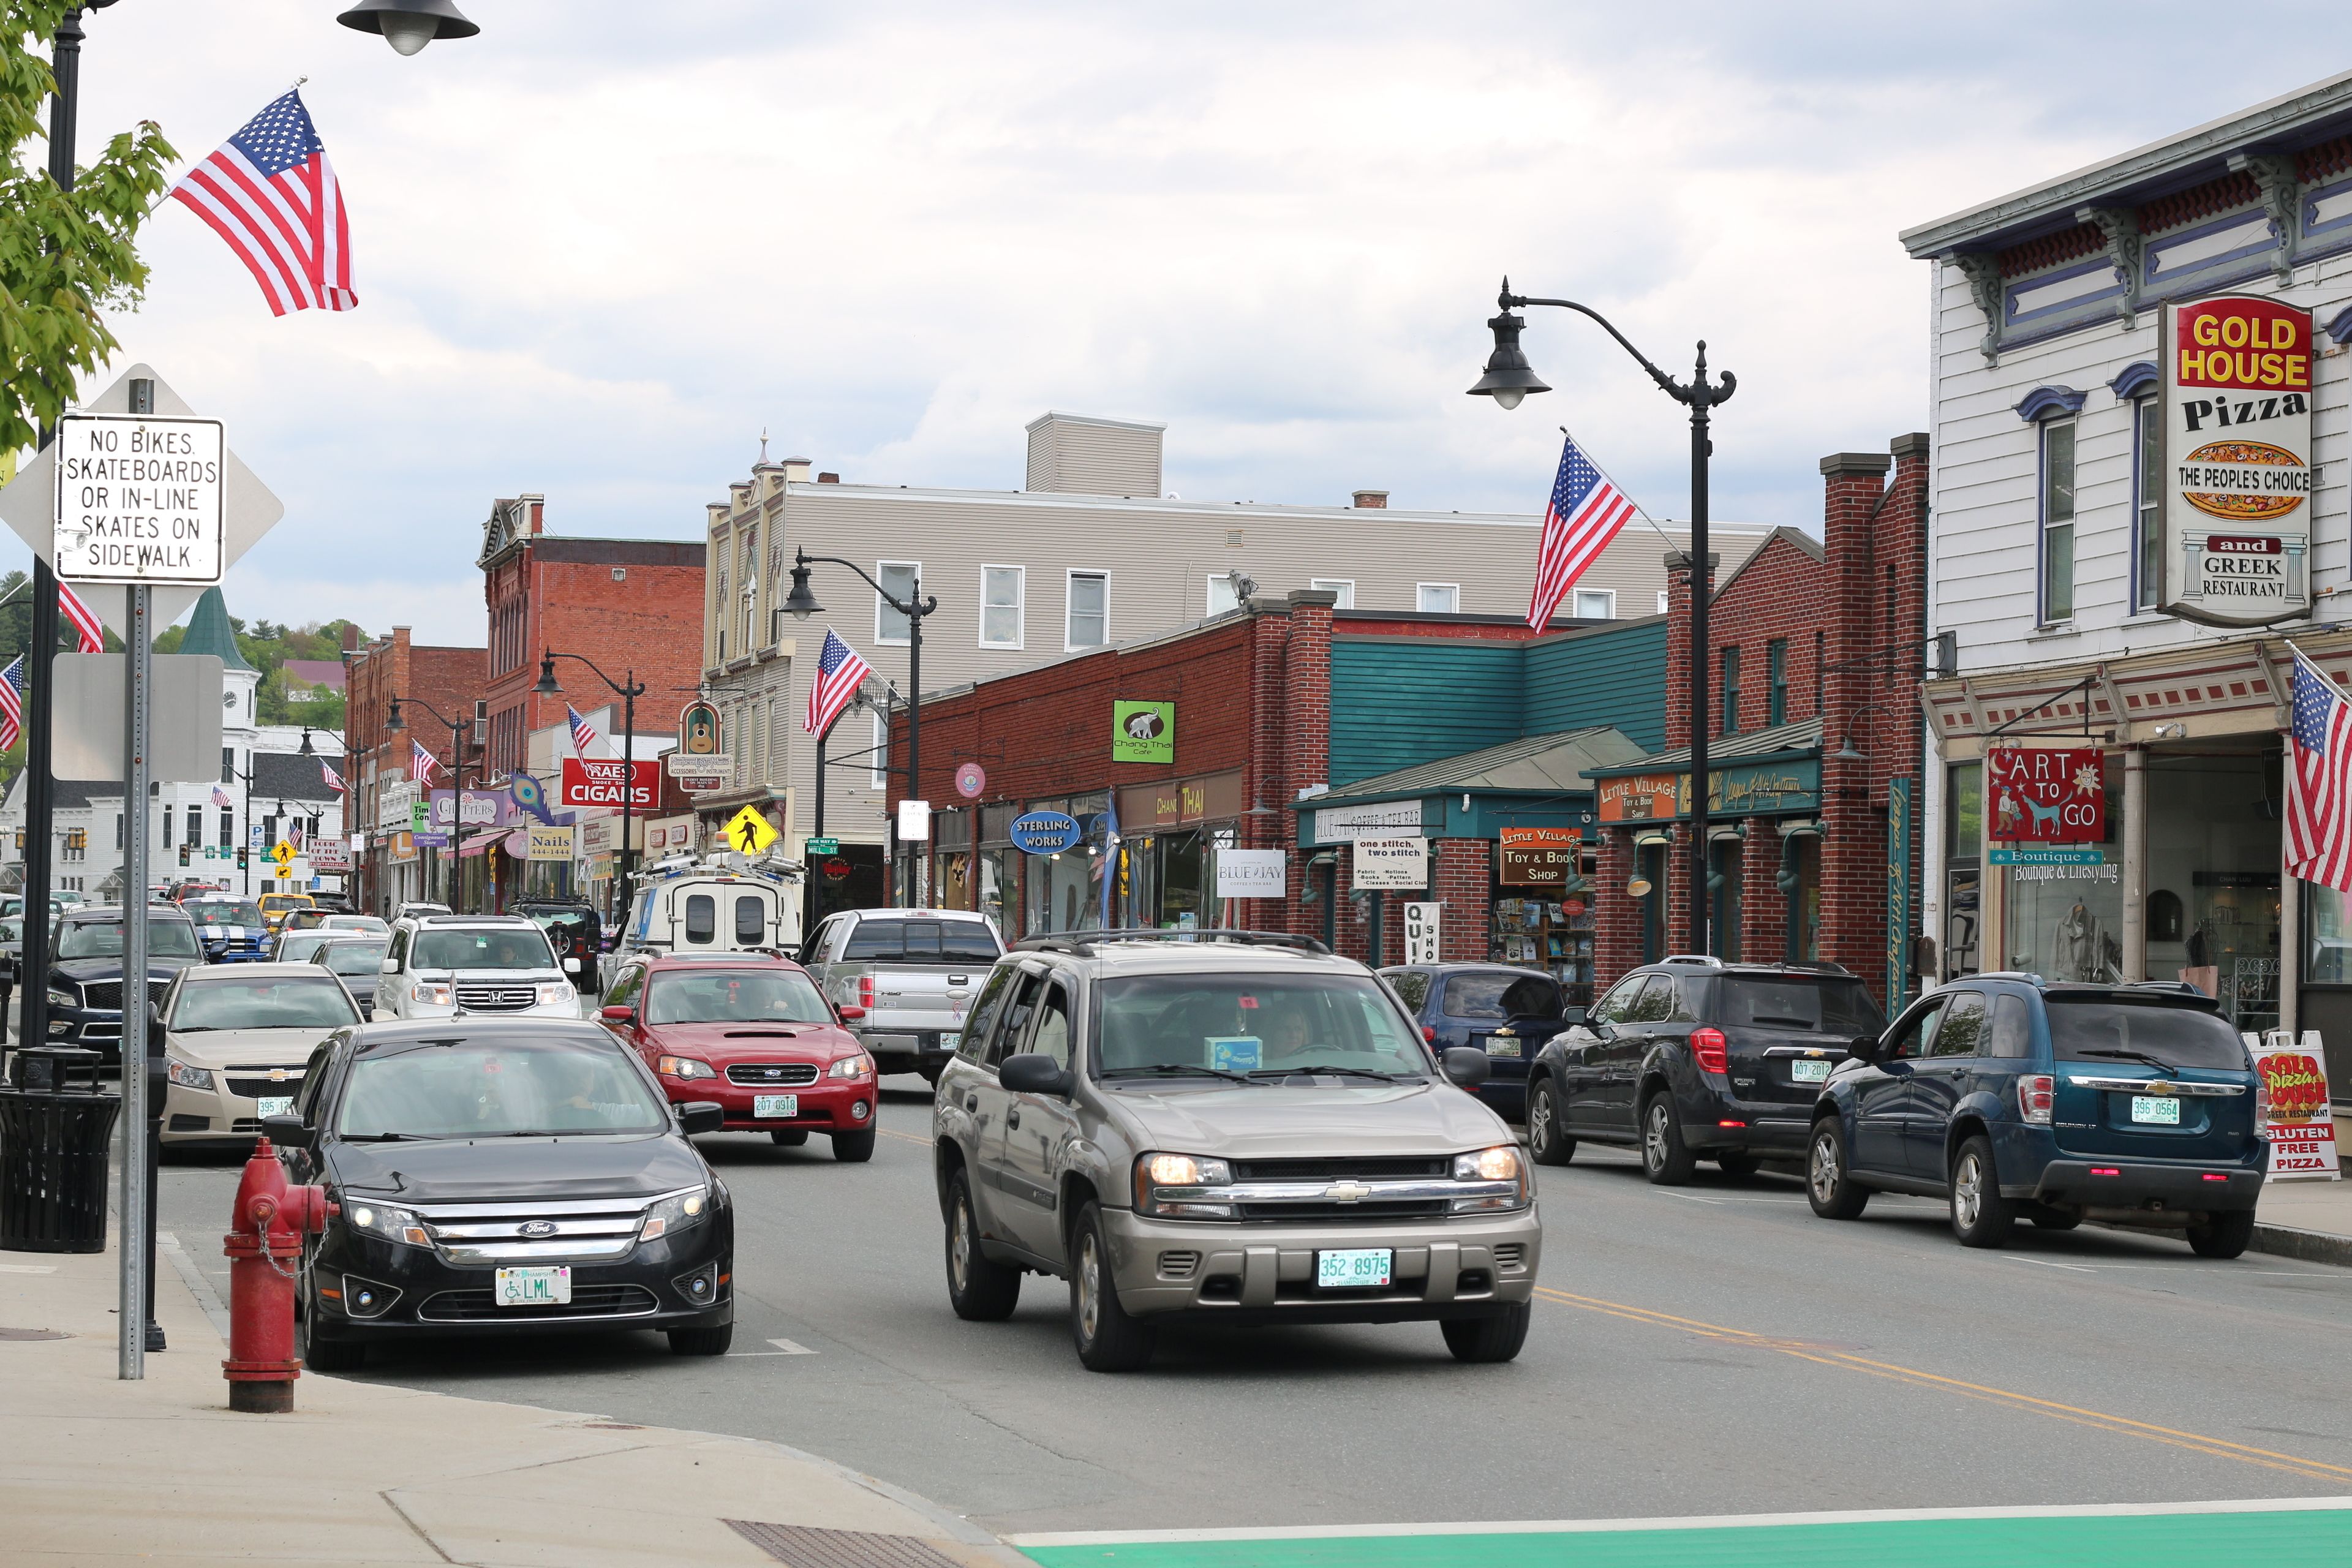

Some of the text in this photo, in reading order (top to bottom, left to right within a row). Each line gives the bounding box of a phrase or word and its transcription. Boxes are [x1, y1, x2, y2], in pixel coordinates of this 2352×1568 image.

[2193, 314, 2297, 350] GOLD
[2180, 349, 2307, 386] HOUSE
[2181, 392, 2308, 432] Pizza
[91, 431, 118, 452] NO
[67, 458, 217, 483] SKATEBOARDS
[2179, 467, 2310, 491] THE PEOPLE'S CHOICE
[81, 486, 198, 510] OR IN-LINE
[82, 515, 200, 540] SKATES ON
[2220, 538, 2269, 552] and
[89, 544, 191, 568] SIDEWALK
[2204, 557, 2282, 575] GREEK
[2203, 579, 2285, 598] RESTAURANT
[1114, 740, 1148, 748] Chang
[2009, 753, 2071, 780] ART
[570, 785, 650, 803] CIGARS
[1600, 776, 1676, 804] LITTLE VILLAGE
[2035, 782, 2060, 799] TO
[440, 799, 493, 815] CHTTERS
[2064, 804, 2096, 826] GO
[253, 826, 262, 835] P
[1017, 820, 1071, 832] STERLING
[1316, 813, 1334, 838] BLUE
[1351, 815, 1379, 831] COFFEE
[532, 837, 570, 846] Nails
[1025, 837, 1063, 847] WORKS
[1382, 840, 1414, 849] stitch,
[1502, 833, 1533, 845] LITTLE
[1506, 851, 1576, 864] TOY & BOOK
[2011, 851, 2081, 864] Boutique
[1219, 866, 1284, 879] BLUE JAY
[1528, 868, 1558, 880] SHOP
[2015, 865, 2054, 885] Boutique
[2057, 865, 2065, 880] &
[1408, 905, 1434, 964] QUI SHO
[1795, 1064, 1830, 1076] 407 2012
[2257, 1055, 2318, 1079] GOLD
[2267, 1069, 2315, 1095] Pizza
[260, 1101, 274, 1112] 395
[756, 1099, 795, 1110] 207 0918
[2135, 1102, 2177, 1115] 396 0564
[2267, 1109, 2328, 1119] GREEK RESTAURANT
[2266, 1127, 2329, 1140] GLUTEN
[2277, 1143, 2320, 1154] FREE
[2276, 1158, 2326, 1169] PIZZA
[526, 1223, 550, 1233] Ford
[1321, 1257, 1389, 1276] 352 8975
[524, 1278, 554, 1299] LML
